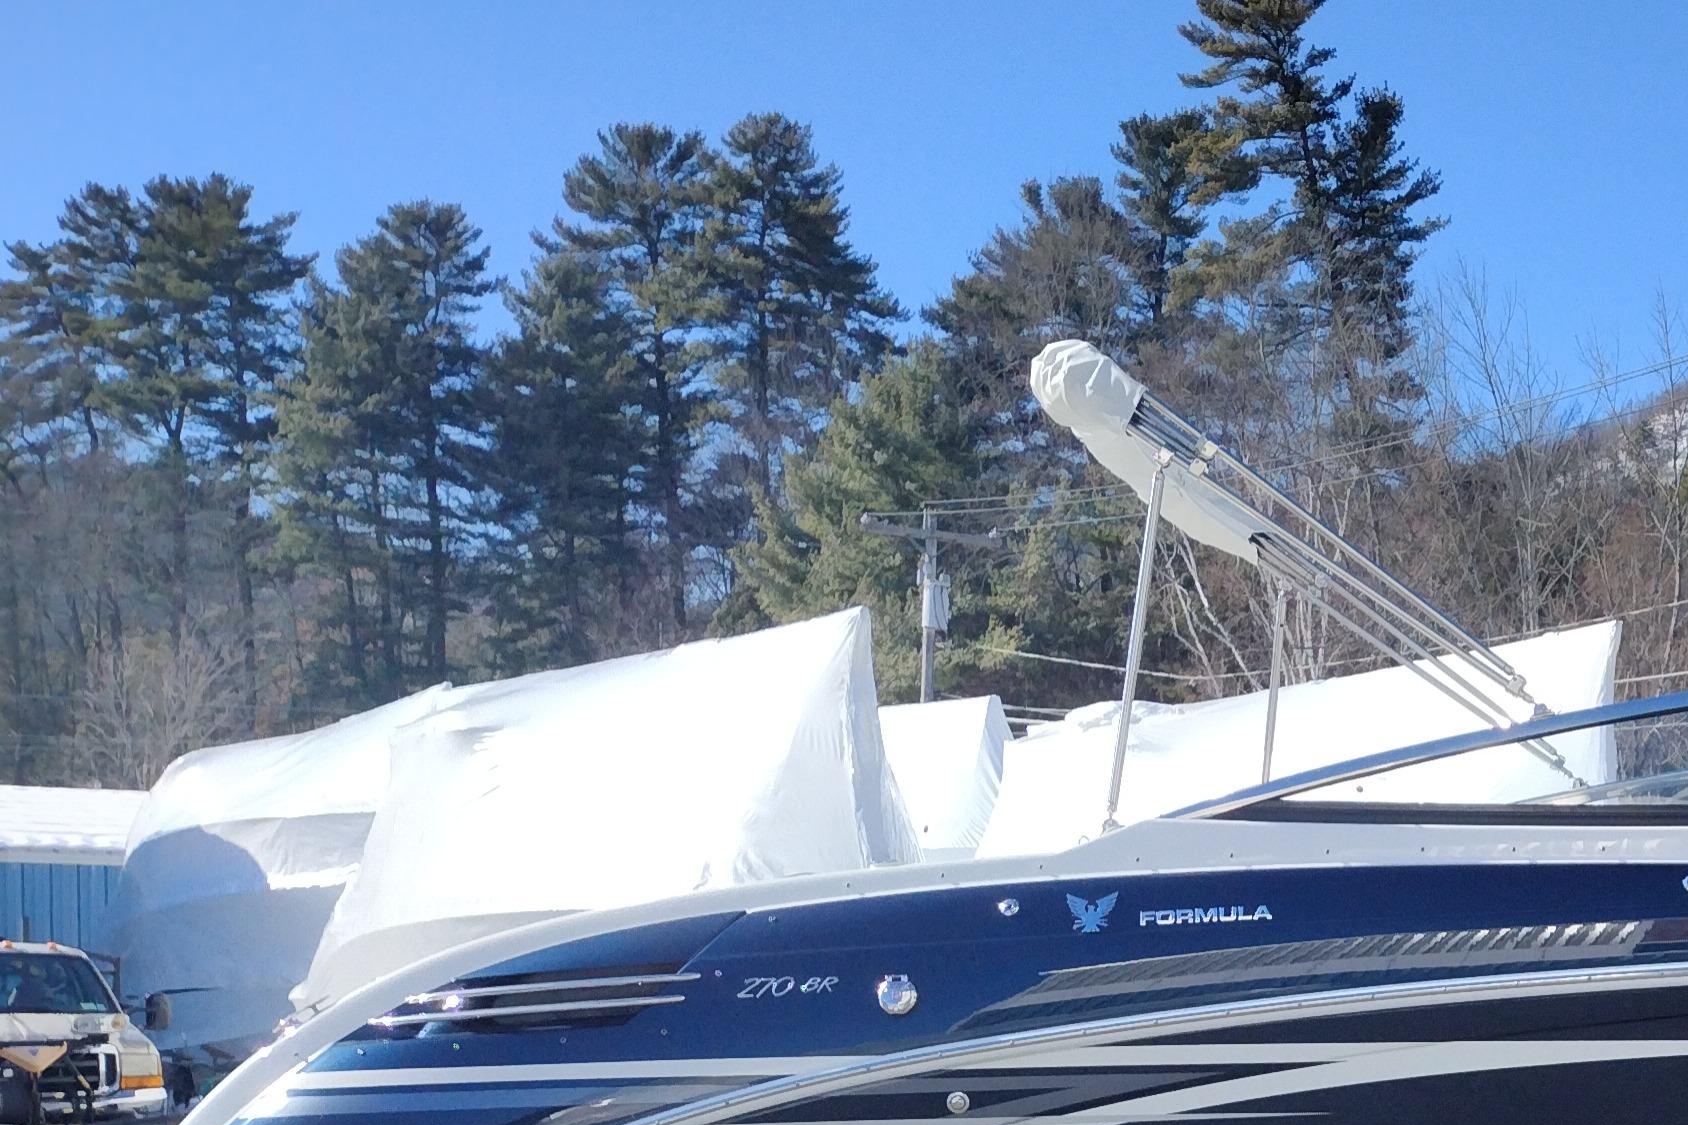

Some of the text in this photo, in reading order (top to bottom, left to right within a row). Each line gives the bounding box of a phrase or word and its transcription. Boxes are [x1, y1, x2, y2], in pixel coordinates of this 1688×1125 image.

[1139, 904, 1273, 926] FORMULA
[736, 976, 840, 998] 270 BR
